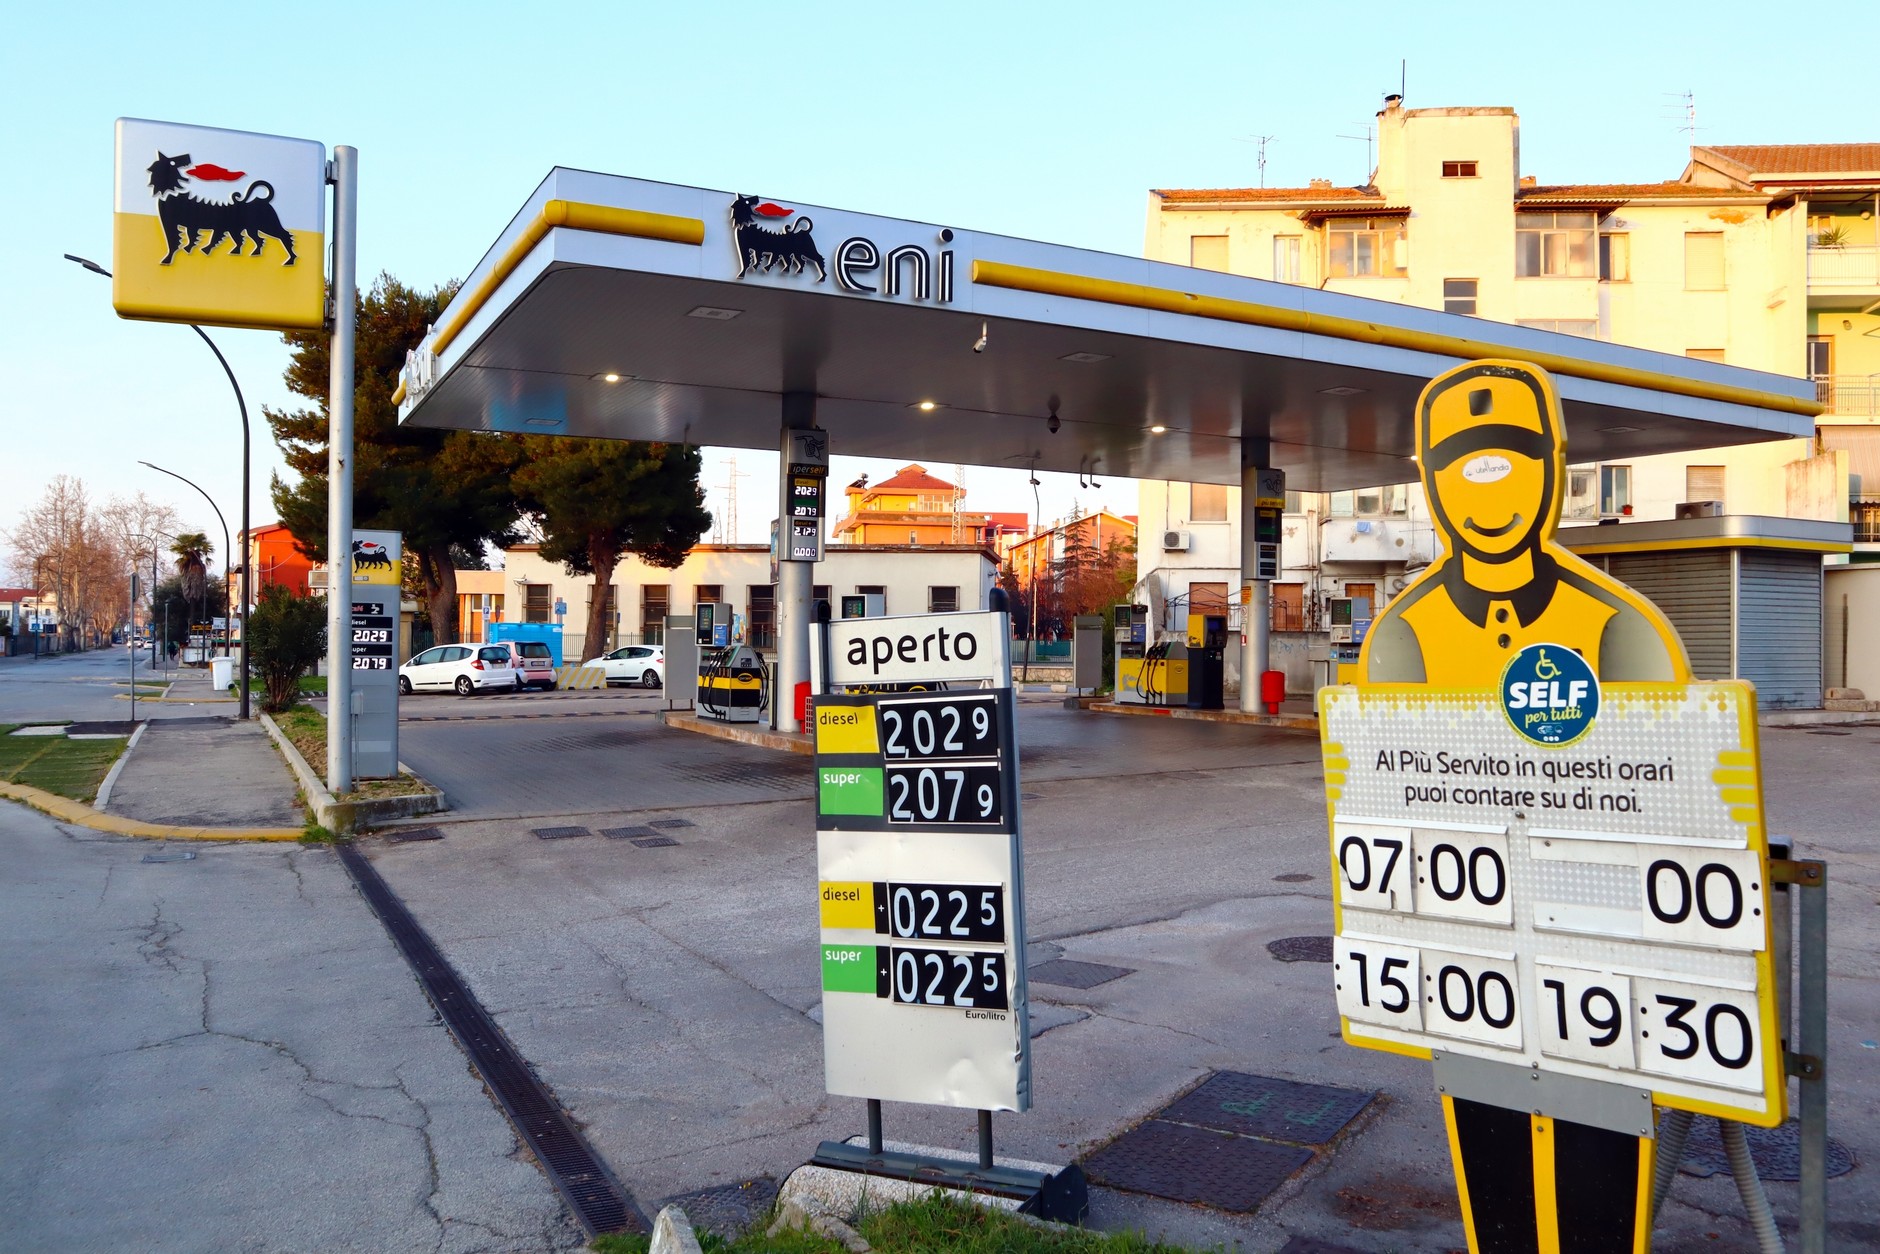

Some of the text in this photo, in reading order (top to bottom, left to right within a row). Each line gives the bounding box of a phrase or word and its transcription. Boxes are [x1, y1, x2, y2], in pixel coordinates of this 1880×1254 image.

[835, 228, 954, 303] eni
[847, 627, 977, 674] aperto
[1508, 680, 1589, 709] SELF
[820, 712, 858, 725] diesel
[1525, 711, 1548, 729] per
[1551, 704, 1583, 721] tutti
[1400, 750, 1431, 773] Più
[1437, 751, 1510, 776] Servito
[1515, 753, 1536, 777] in
[1542, 755, 1612, 783] questi
[1618, 757, 1674, 781] orari
[823, 772, 861, 787] super
[1405, 781, 1642, 813] puoi contare su di noi.
[823, 888, 860, 901] diesel
[825, 948, 862, 964] super
[965, 1010, 1006, 1021] Euro/litro
